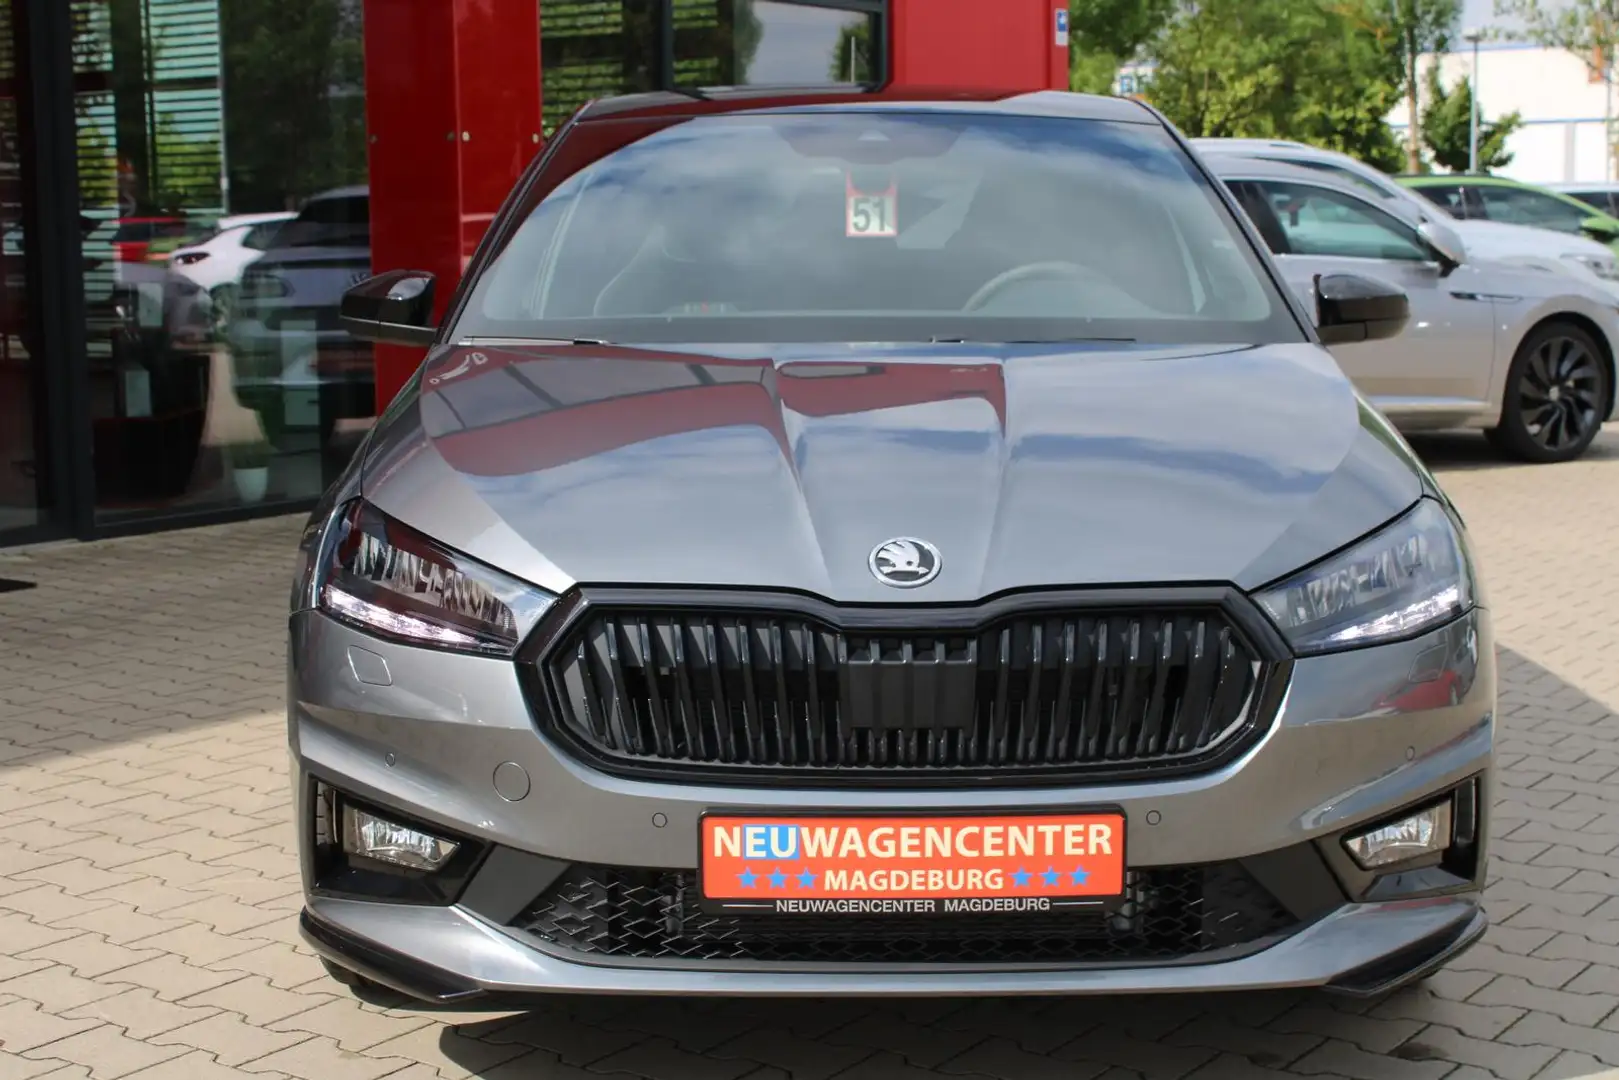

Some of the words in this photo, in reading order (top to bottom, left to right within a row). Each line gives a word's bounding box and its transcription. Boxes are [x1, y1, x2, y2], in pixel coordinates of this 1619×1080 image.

[852, 197, 885, 233] 51
[713, 824, 1112, 858] NEUWAGENCENTER
[824, 868, 1004, 891] MAGDEBURG
[776, 899, 935, 913] NEUWAGENCENTER
[944, 898, 1051, 912] MAGDEBURG
